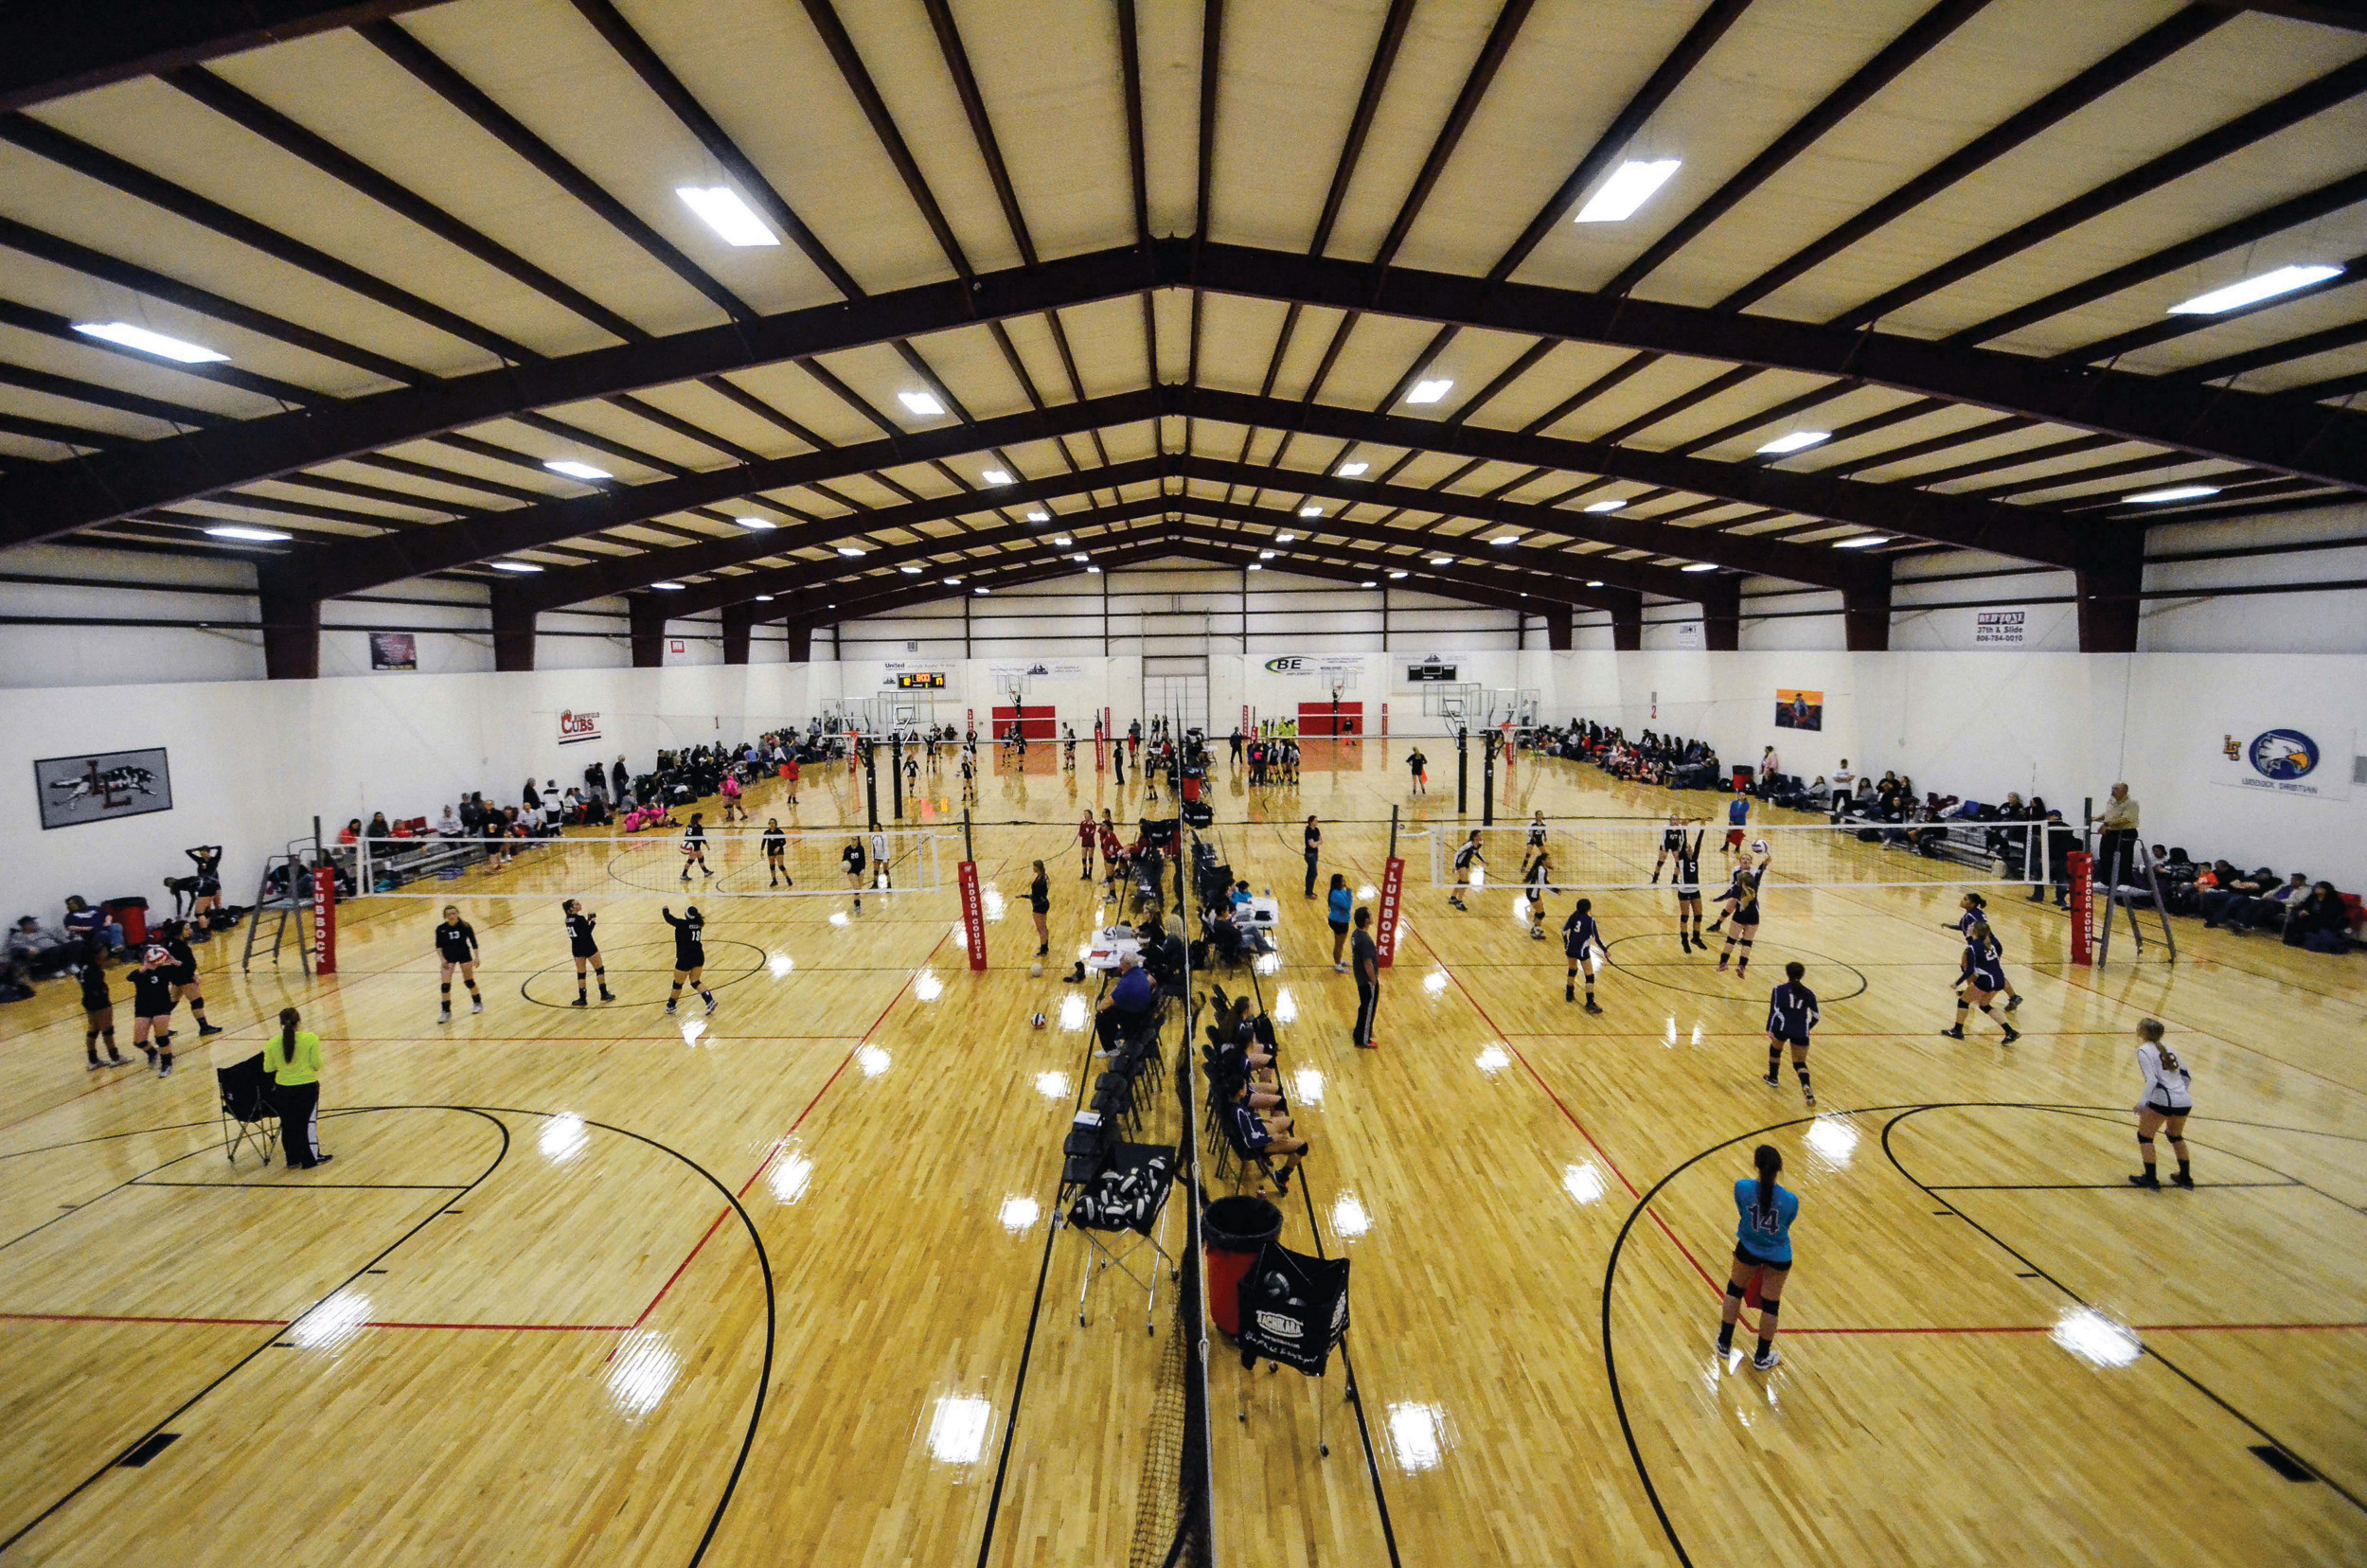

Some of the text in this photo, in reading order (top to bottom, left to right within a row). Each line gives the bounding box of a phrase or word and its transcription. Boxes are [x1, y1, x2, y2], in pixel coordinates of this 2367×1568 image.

[1277, 659, 1302, 669] BE
[1689, 862, 1697, 872] 5
[314, 881, 327, 963] LUBBOCK
[968, 875, 983, 960] INDOOR COURTS
[1379, 871, 1397, 956] LUBBOCK
[1574, 920, 1581, 933] 3
[2084, 912, 2092, 954] COURTS
[1747, 1203, 1779, 1235] 14
[1255, 1310, 1304, 1338] TACHIKARA
